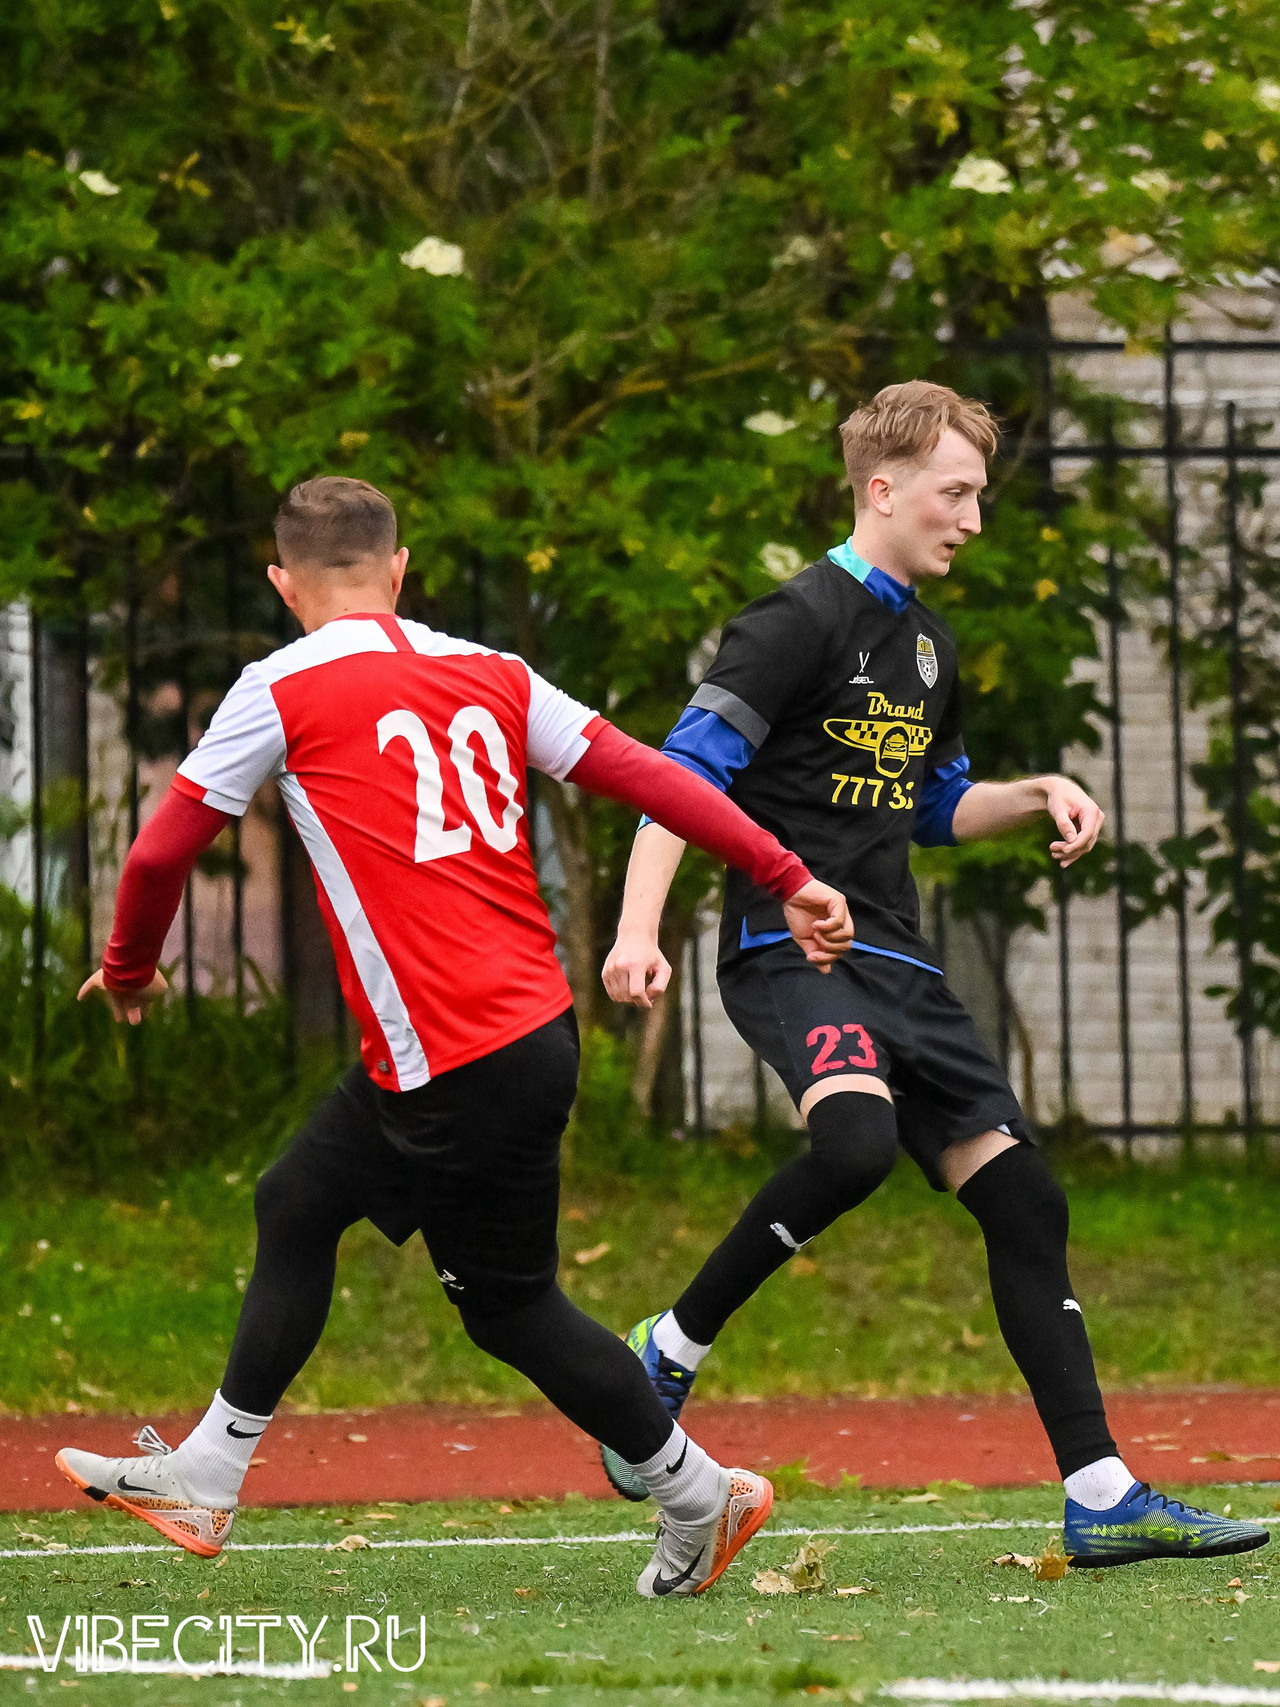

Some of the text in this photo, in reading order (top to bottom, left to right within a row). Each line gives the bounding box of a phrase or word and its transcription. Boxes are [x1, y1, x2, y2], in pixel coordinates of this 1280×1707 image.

[867, 692, 925, 721] Brand
[376, 705, 524, 863] 20
[832, 773, 884, 808] 777
[806, 1023, 878, 1075] 23
